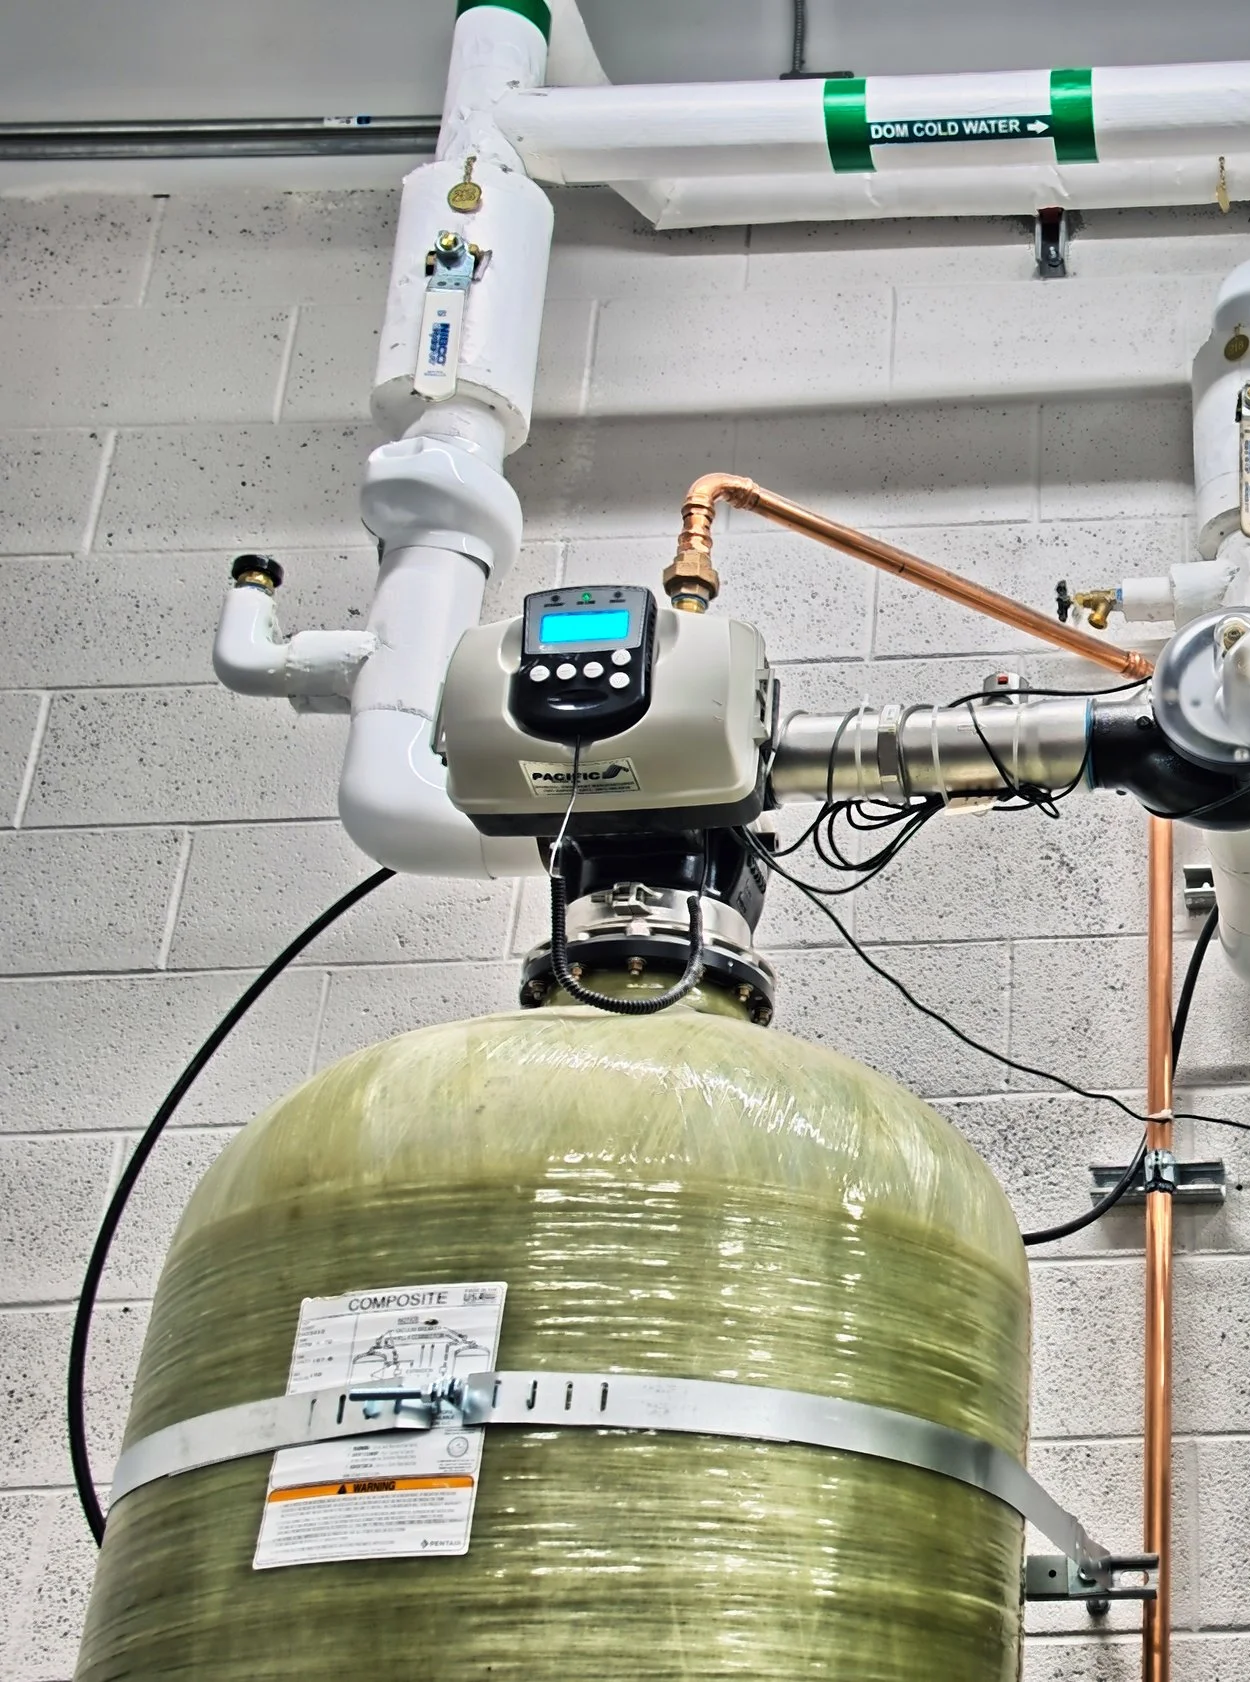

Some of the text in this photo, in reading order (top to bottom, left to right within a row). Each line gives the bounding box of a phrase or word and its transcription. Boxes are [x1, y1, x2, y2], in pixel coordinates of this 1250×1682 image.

[870, 119, 1020, 139] DOM COLD WATER
[436, 323, 450, 366] NIBCO
[348, 1291, 448, 1312] COMPOSITE
[353, 1481, 396, 1493] WARNING
